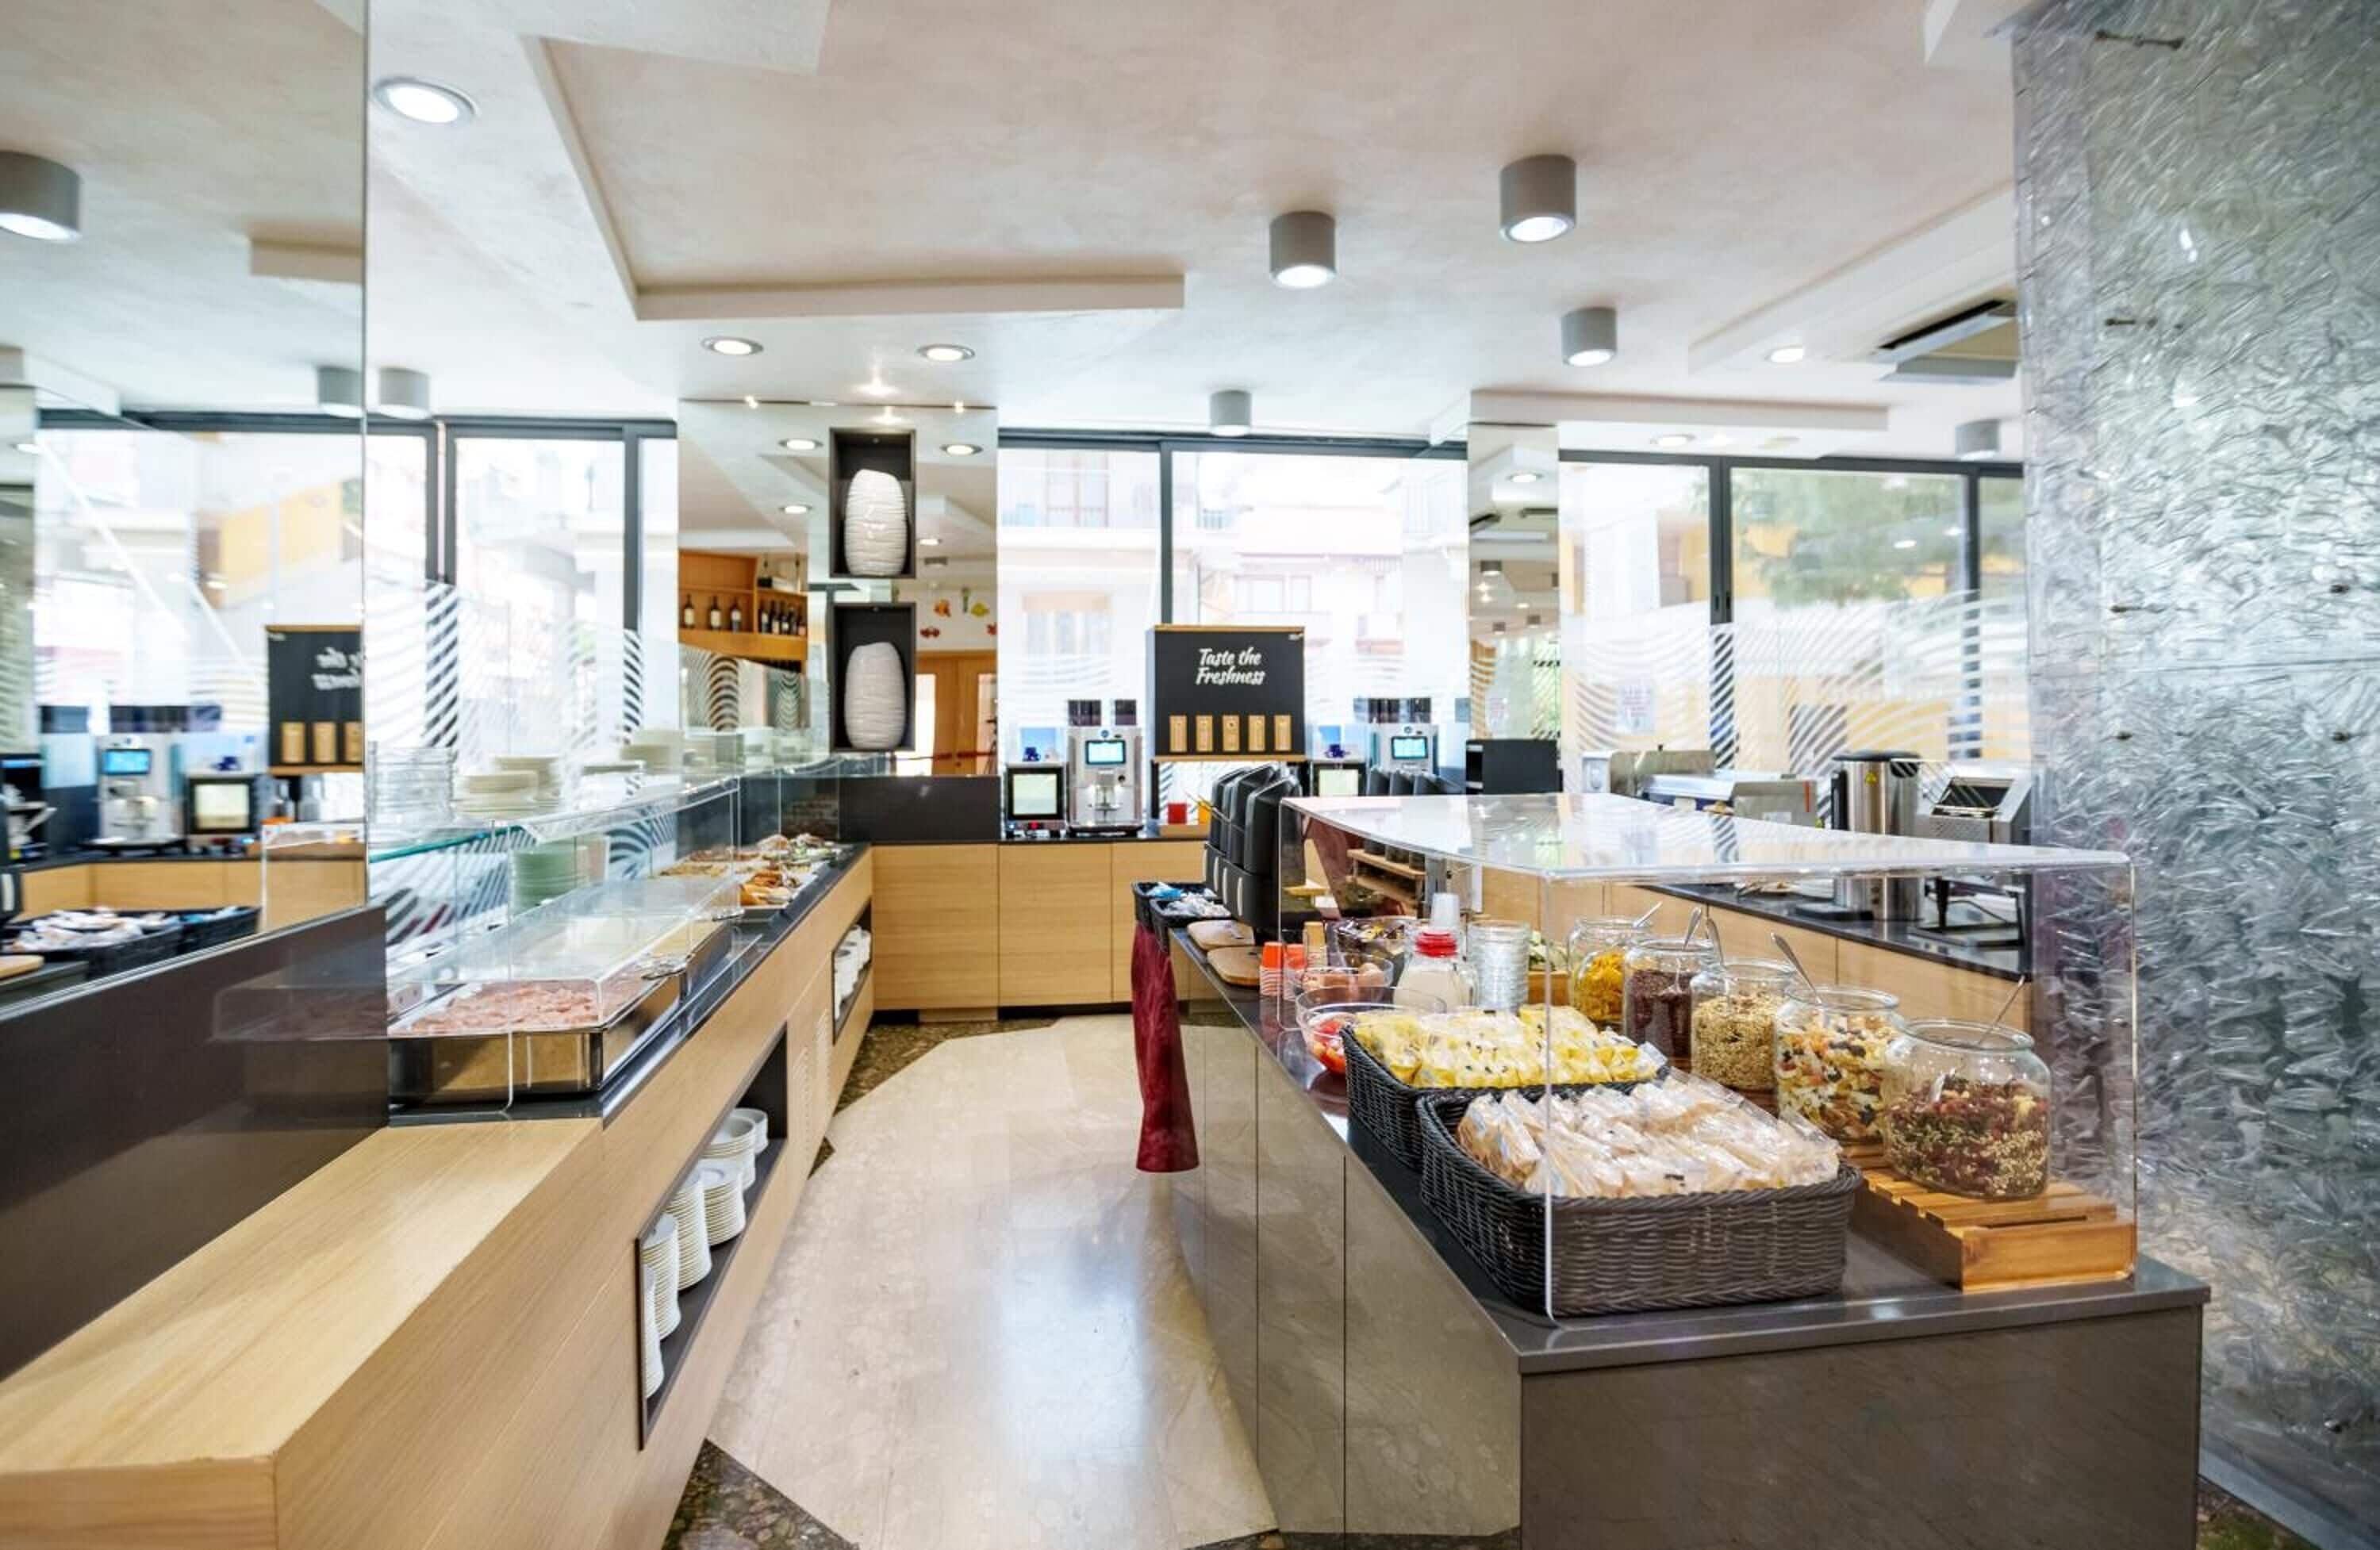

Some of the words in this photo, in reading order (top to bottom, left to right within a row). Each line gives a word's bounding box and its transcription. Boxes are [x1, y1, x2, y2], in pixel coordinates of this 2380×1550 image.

[1199, 648, 1235, 666] Taste
[1238, 646, 1262, 666] the
[1196, 666, 1266, 685] Freshness
